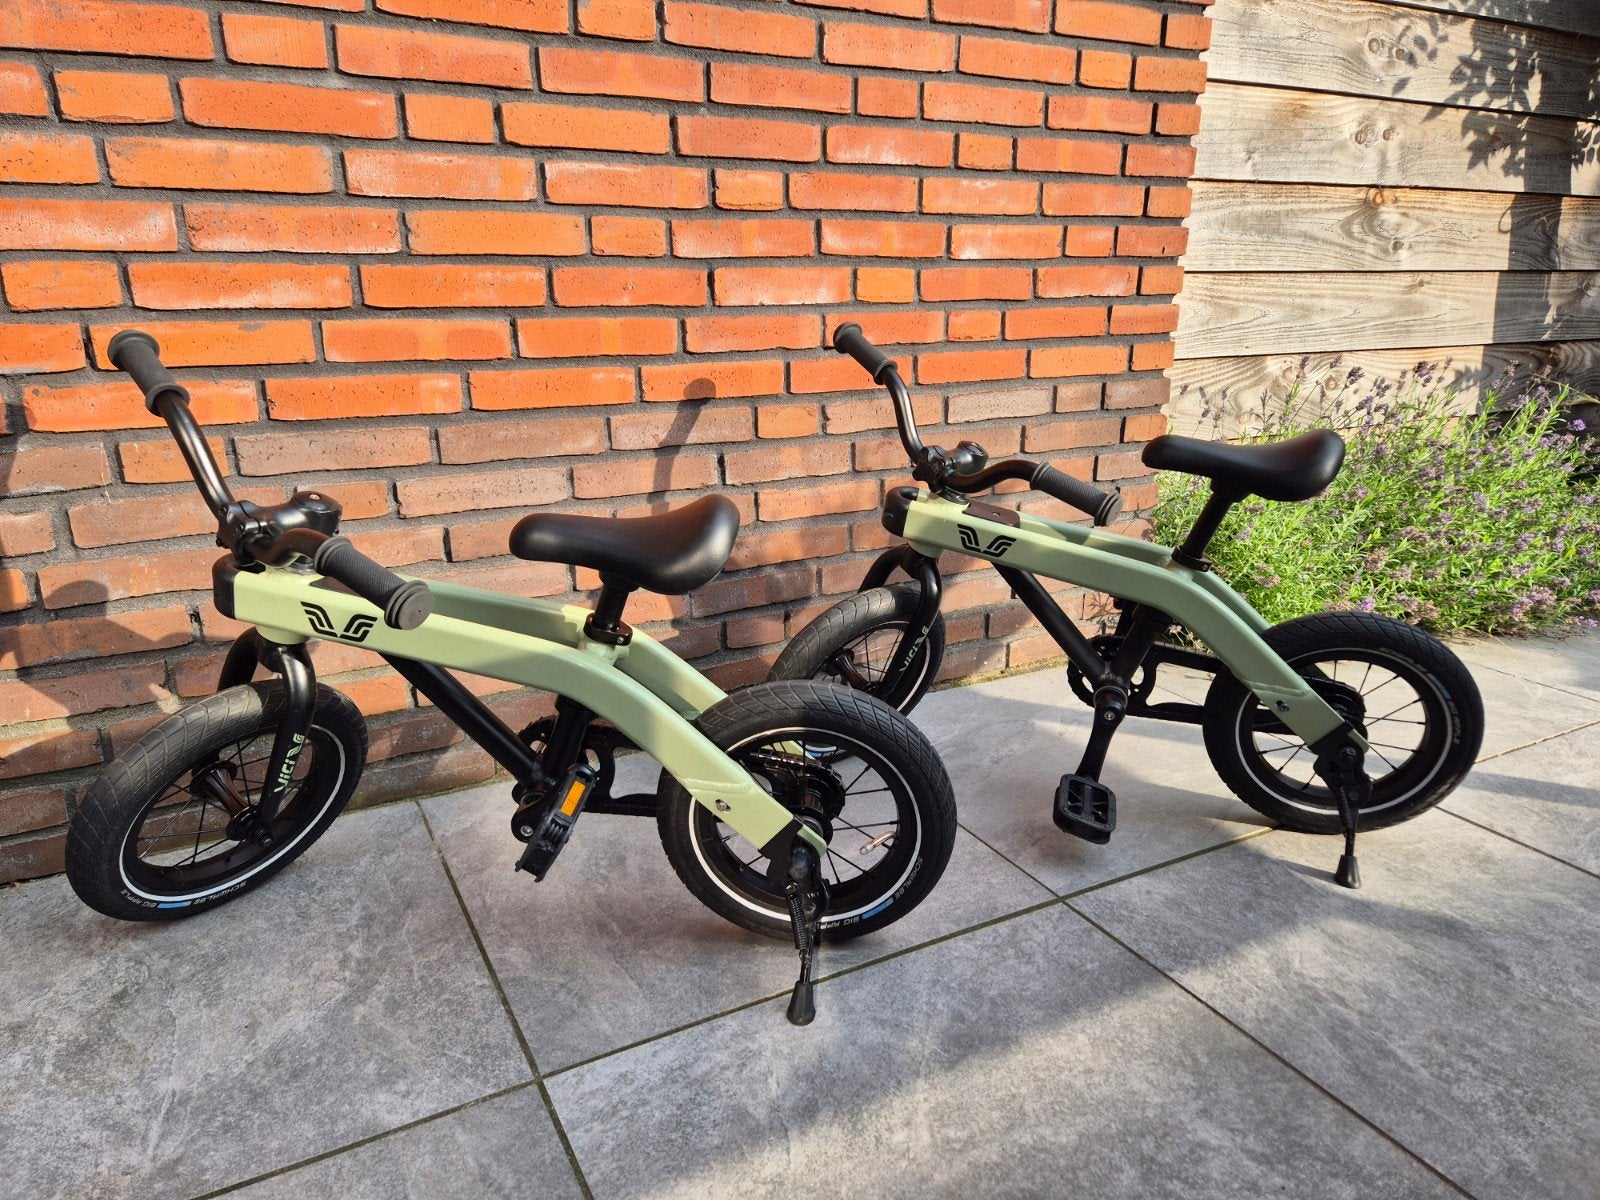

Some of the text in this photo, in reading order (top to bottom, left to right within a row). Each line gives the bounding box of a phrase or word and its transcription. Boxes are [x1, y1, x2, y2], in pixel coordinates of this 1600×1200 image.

[894, 856, 923, 899] SCHWALBE
[120, 889, 143, 904] APPLE
[193, 880, 247, 905] SCHWALBE
[843, 915, 860, 926] BIG
